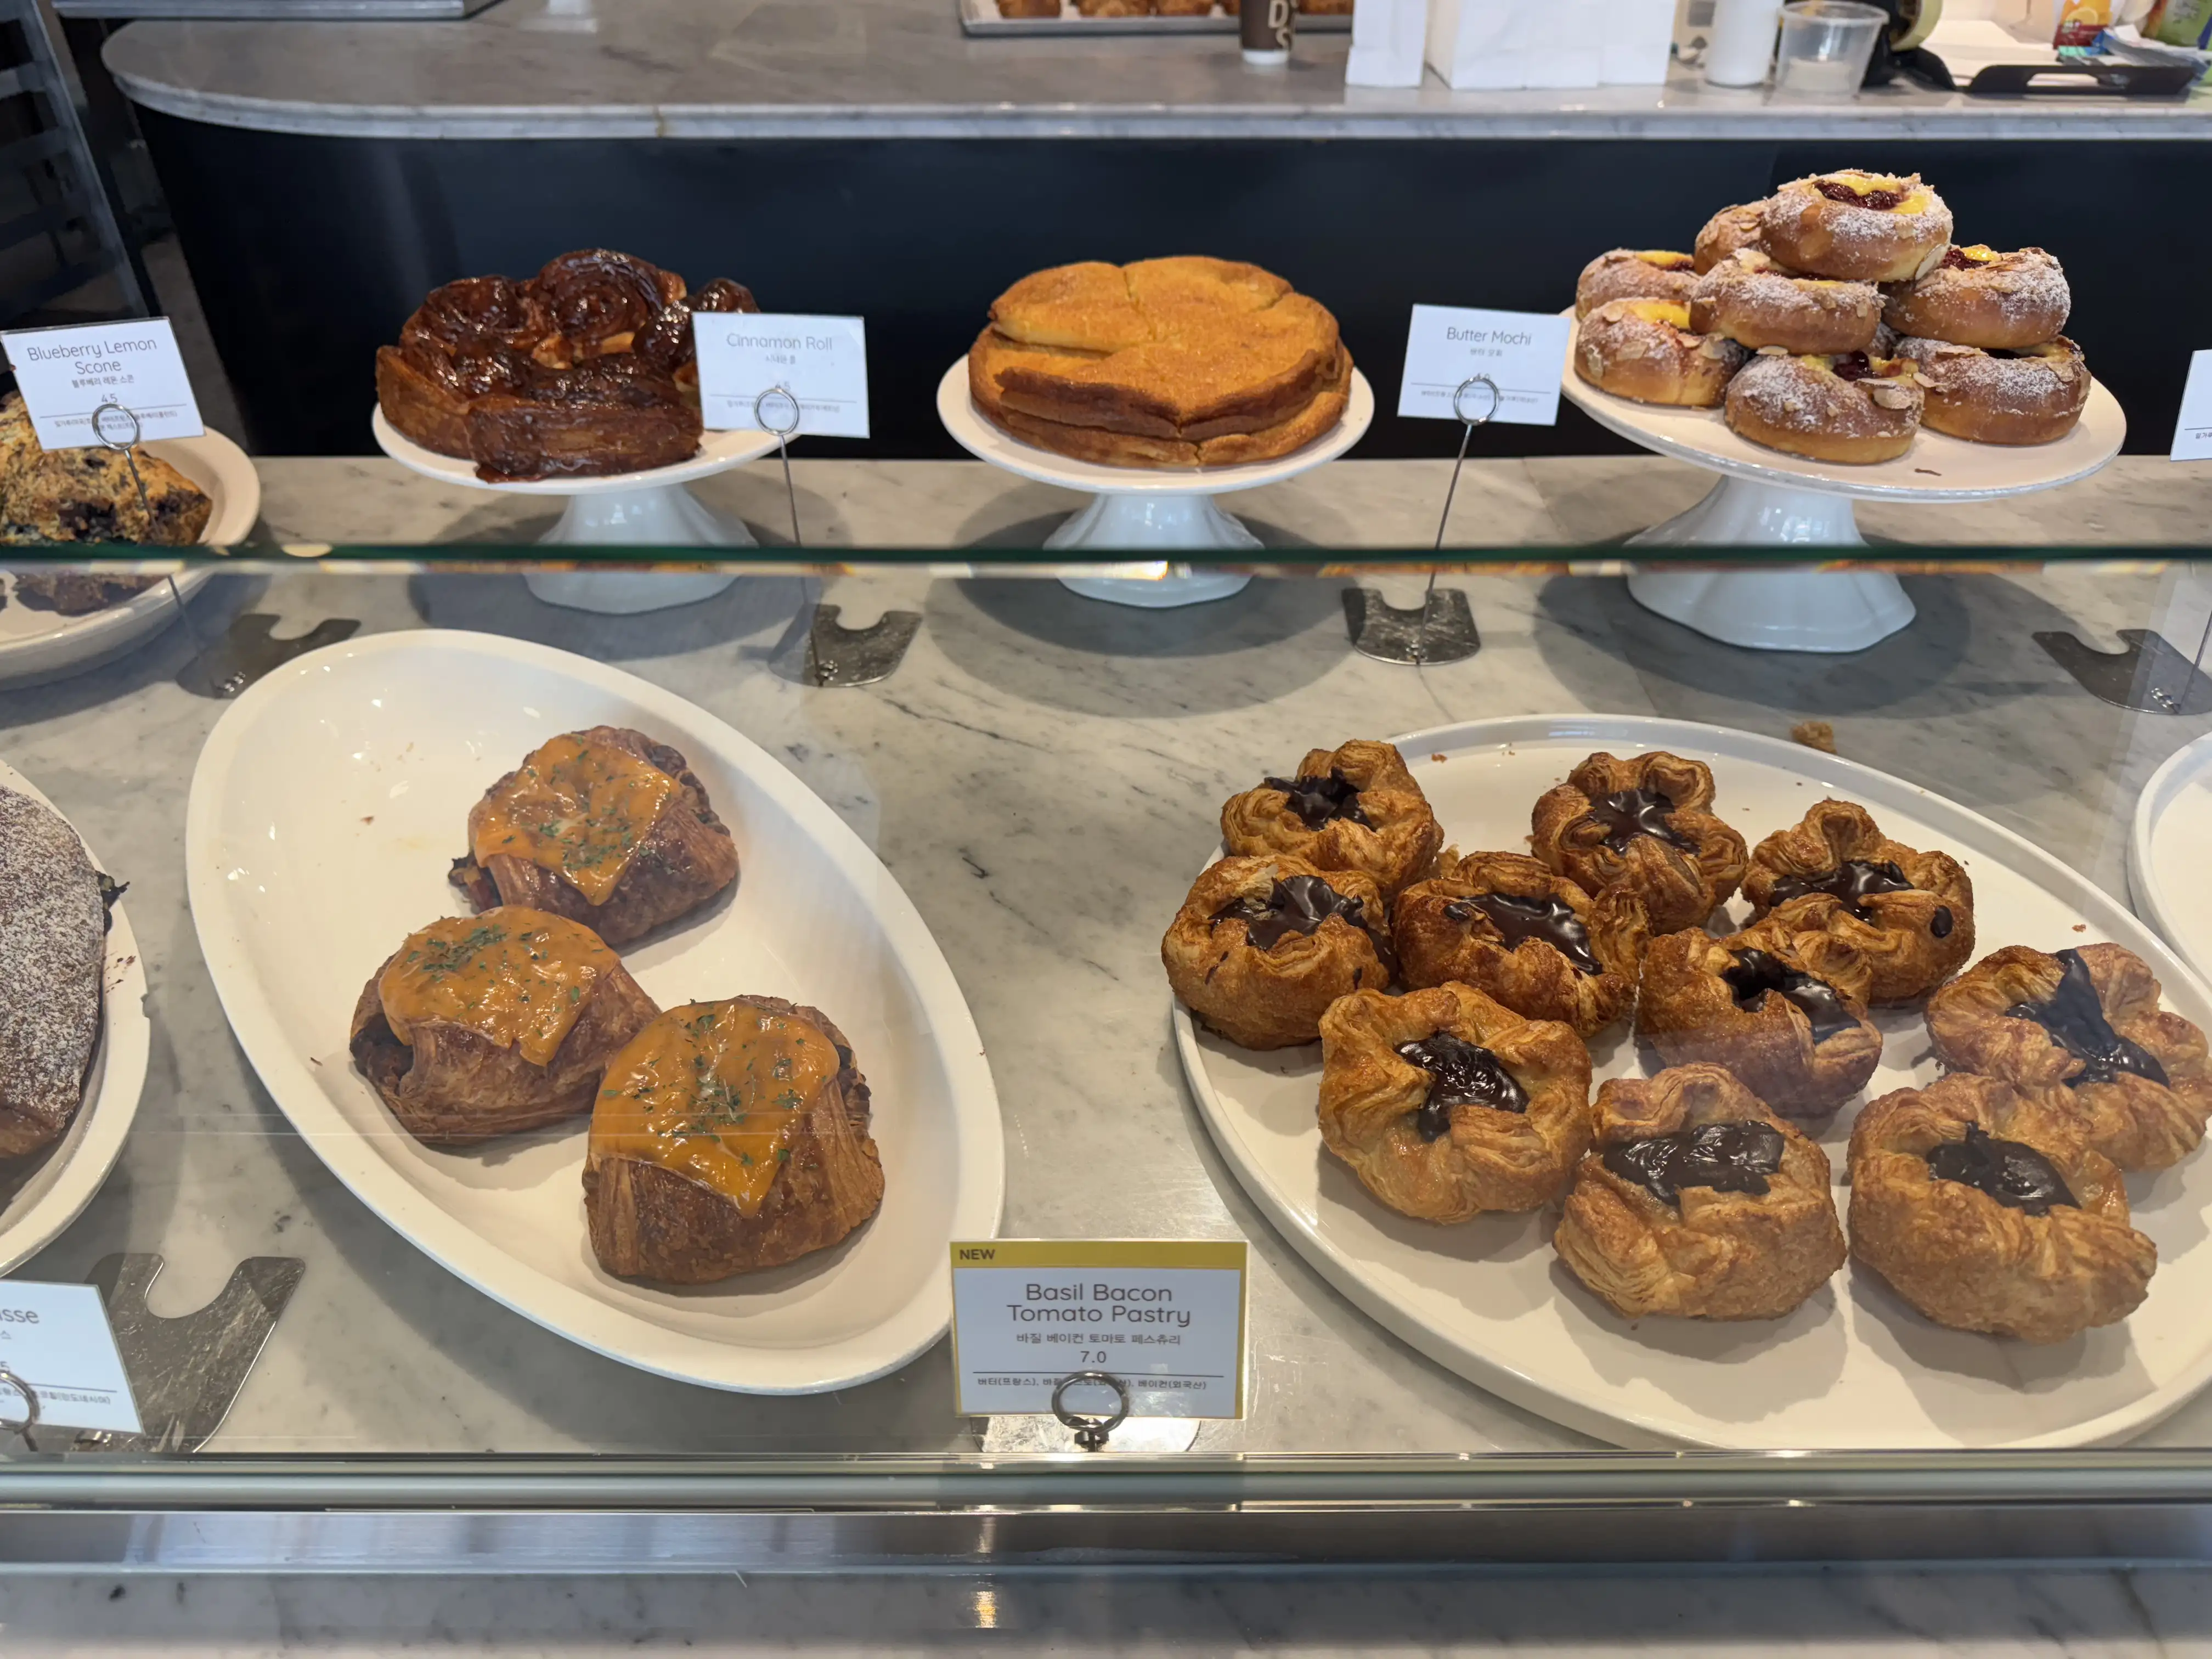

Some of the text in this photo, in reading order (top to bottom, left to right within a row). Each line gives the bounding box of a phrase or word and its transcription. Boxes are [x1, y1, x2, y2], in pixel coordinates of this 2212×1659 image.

[726, 333, 833, 351] Cinnamon Roll
[1447, 327, 1532, 346] Butter Mochi
[27, 338, 157, 361] Blueberry Lemon
[75, 360, 122, 375] Scone
[960, 1249, 996, 1260] NEW
[1026, 1283, 1172, 1302] Basil Bacon
[0, 1308, 40, 1324] sse
[1007, 1305, 1191, 1328] Tomato Pastry
[1016, 1333, 1181, 1346] 바질 베이컨 토마토 페스츄리
[1080, 1350, 1108, 1364] 7.0
